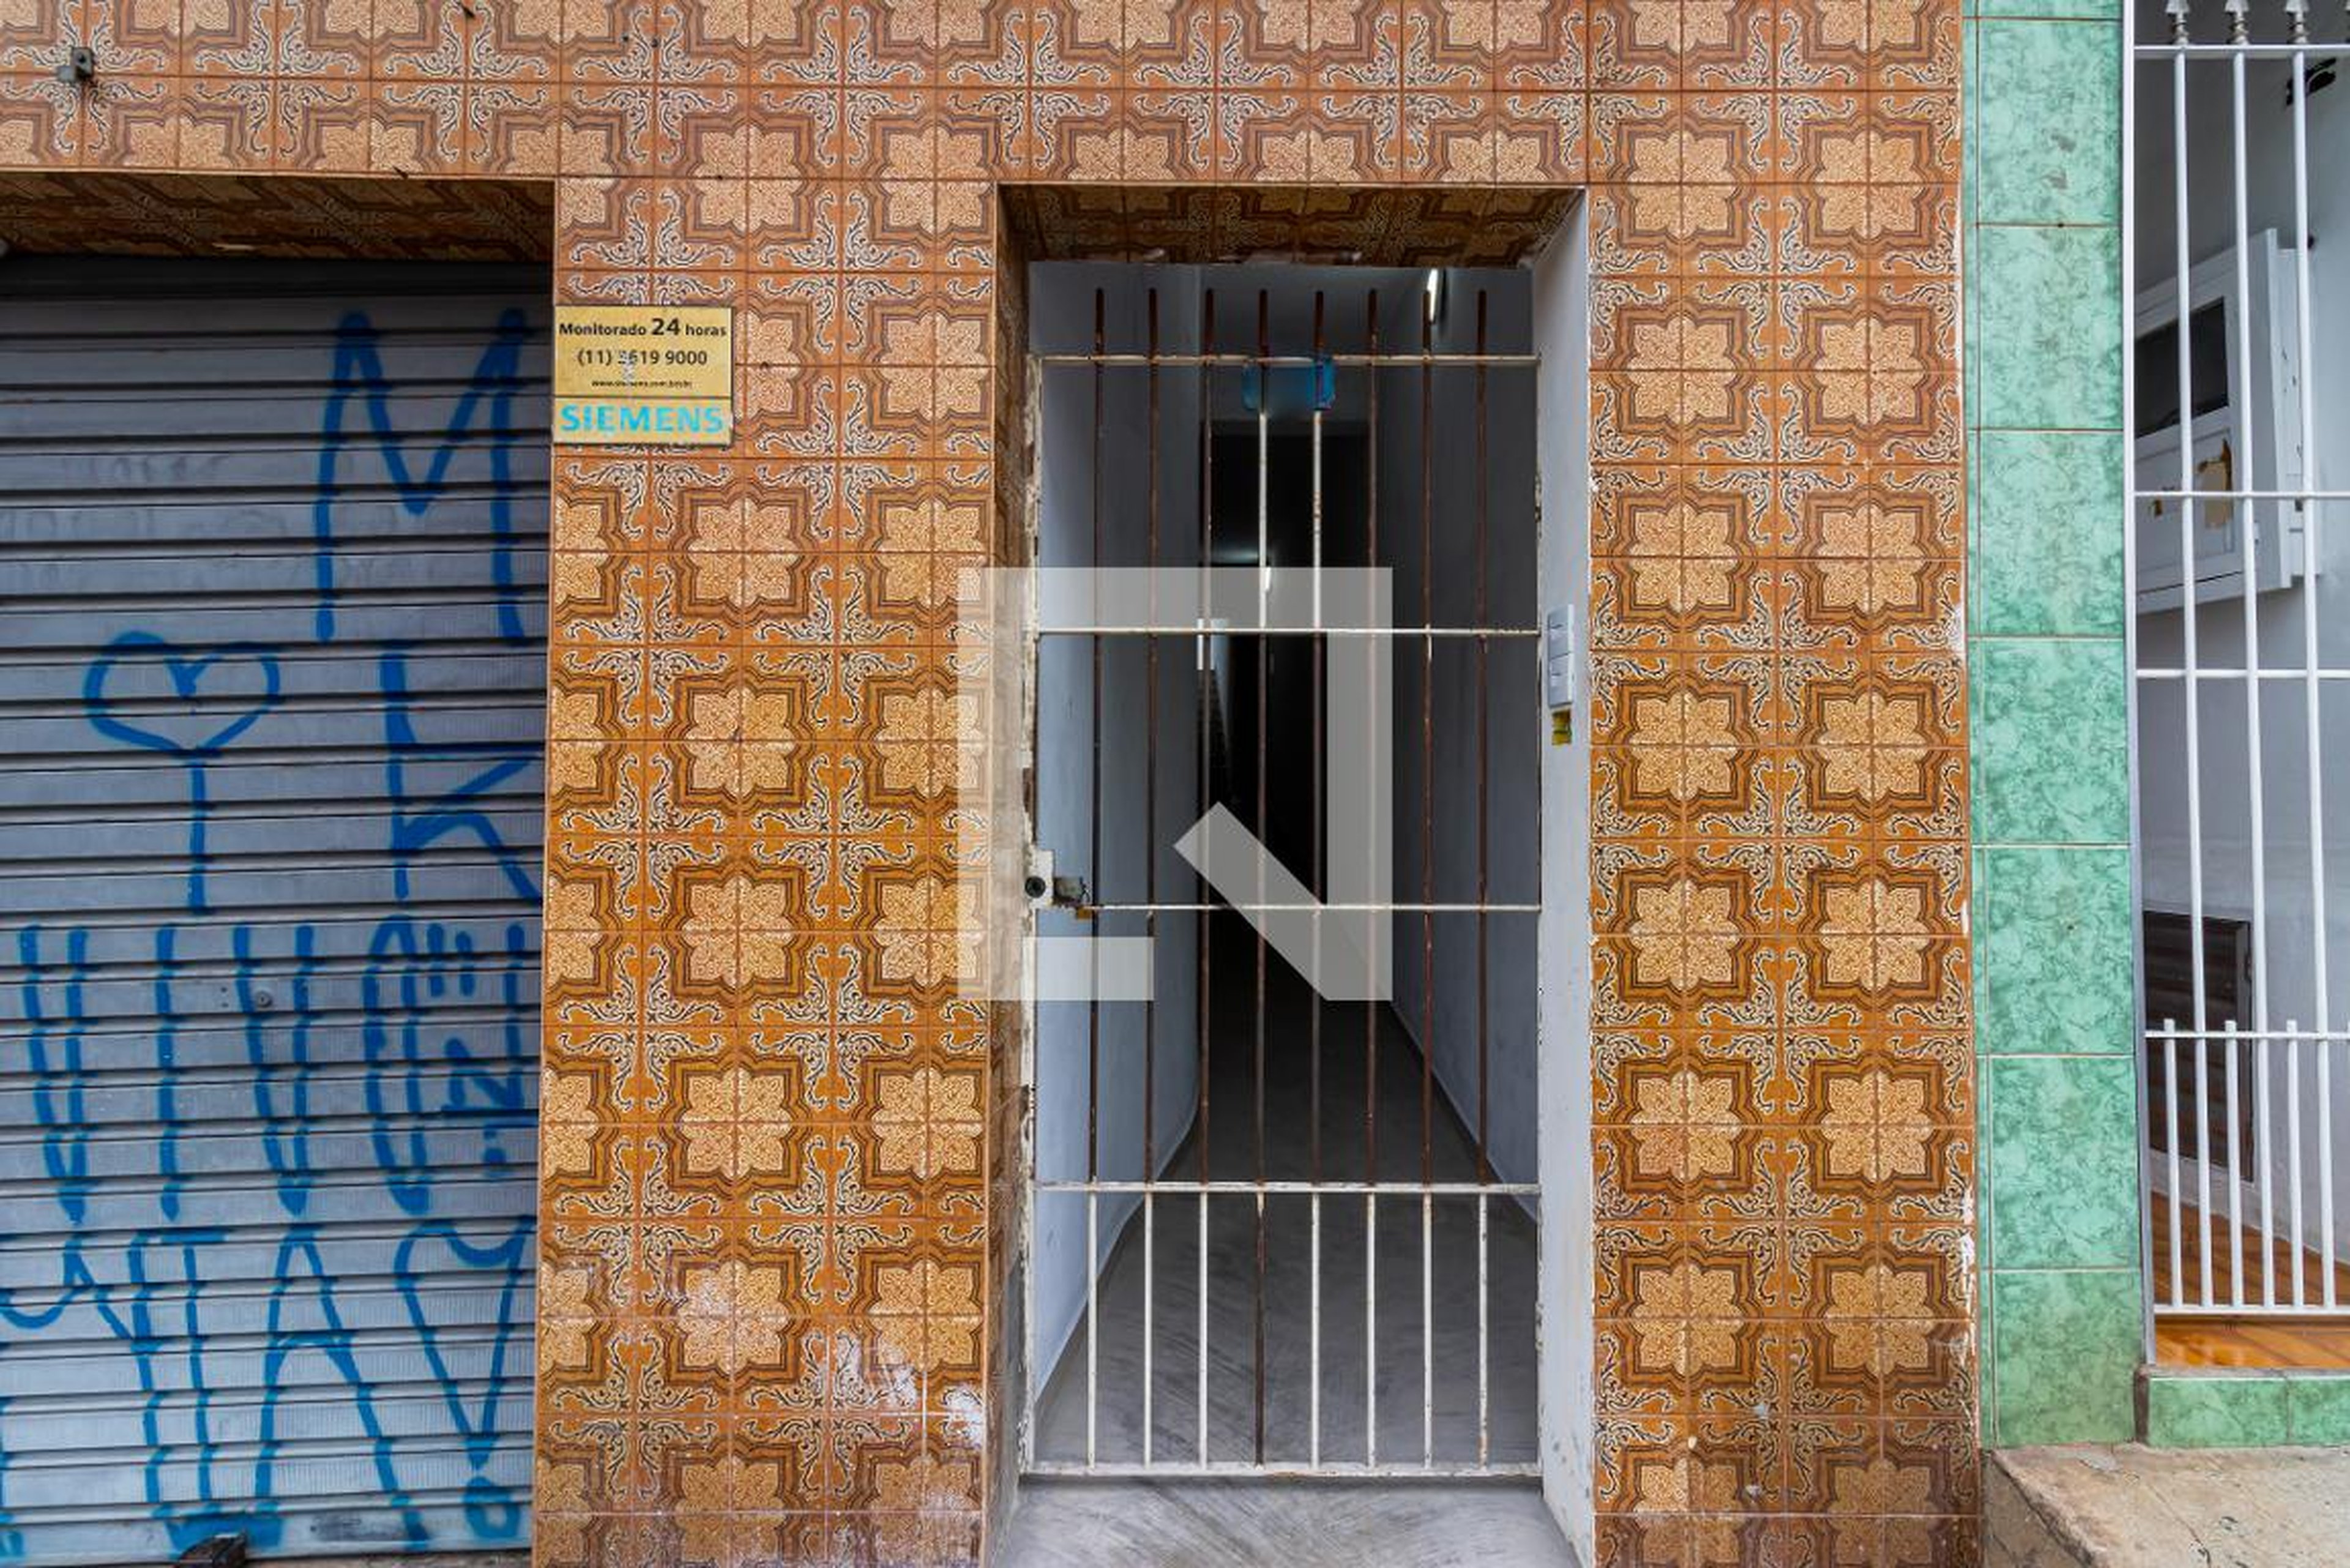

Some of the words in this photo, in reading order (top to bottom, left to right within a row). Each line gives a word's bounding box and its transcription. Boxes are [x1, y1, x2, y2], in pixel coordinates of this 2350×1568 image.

[559, 323, 647, 336] Monitorado
[651, 317, 681, 336] 24
[685, 323, 728, 337] horas
[577, 349, 612, 367] (11)
[665, 349, 708, 365] 9000
[559, 403, 725, 434] SIEMENS
